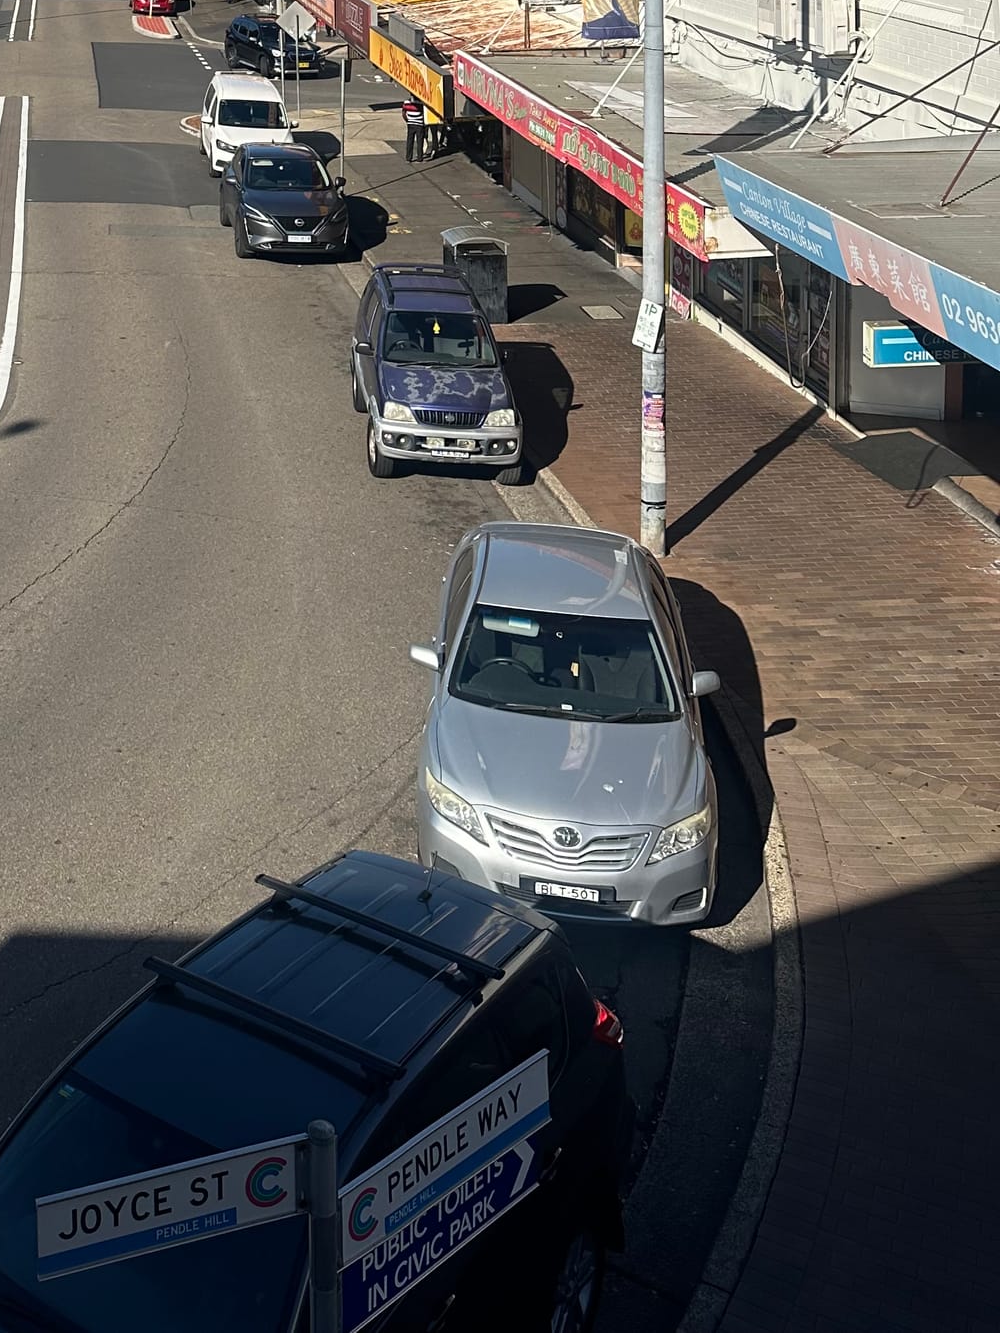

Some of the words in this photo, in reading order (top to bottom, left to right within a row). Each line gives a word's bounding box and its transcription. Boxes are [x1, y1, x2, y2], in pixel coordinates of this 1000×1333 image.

[739, 201, 772, 230] CHINESE
[771, 217, 825, 259] RESTAURANT
[742, 181, 773, 211] Canton
[773, 197, 806, 233] Village
[849, 239, 931, 313] 廣東菜館
[942, 293, 965, 327] 02
[965, 305, 1000, 345] 963
[903, 349, 959, 362] CHINESE
[387, 1119, 469, 1204] PENDLE
[477, 1082, 522, 1137] WAY
[58, 1185, 172, 1240] JOYCE
[190, 1170, 229, 1207] ST
[156, 1223, 200, 1241] PENDLE
[204, 1212, 230, 1228] HILL
[362, 1214, 428, 1282] PUBLIC
[434, 1160, 504, 1223] TOILETS
[389, 1204, 418, 1225] PENDLE
[419, 1185, 437, 1204] HILL
[367, 1275, 388, 1313] IN
[394, 1231, 444, 1288] CIVIC
[450, 1189, 496, 1246] PARK
